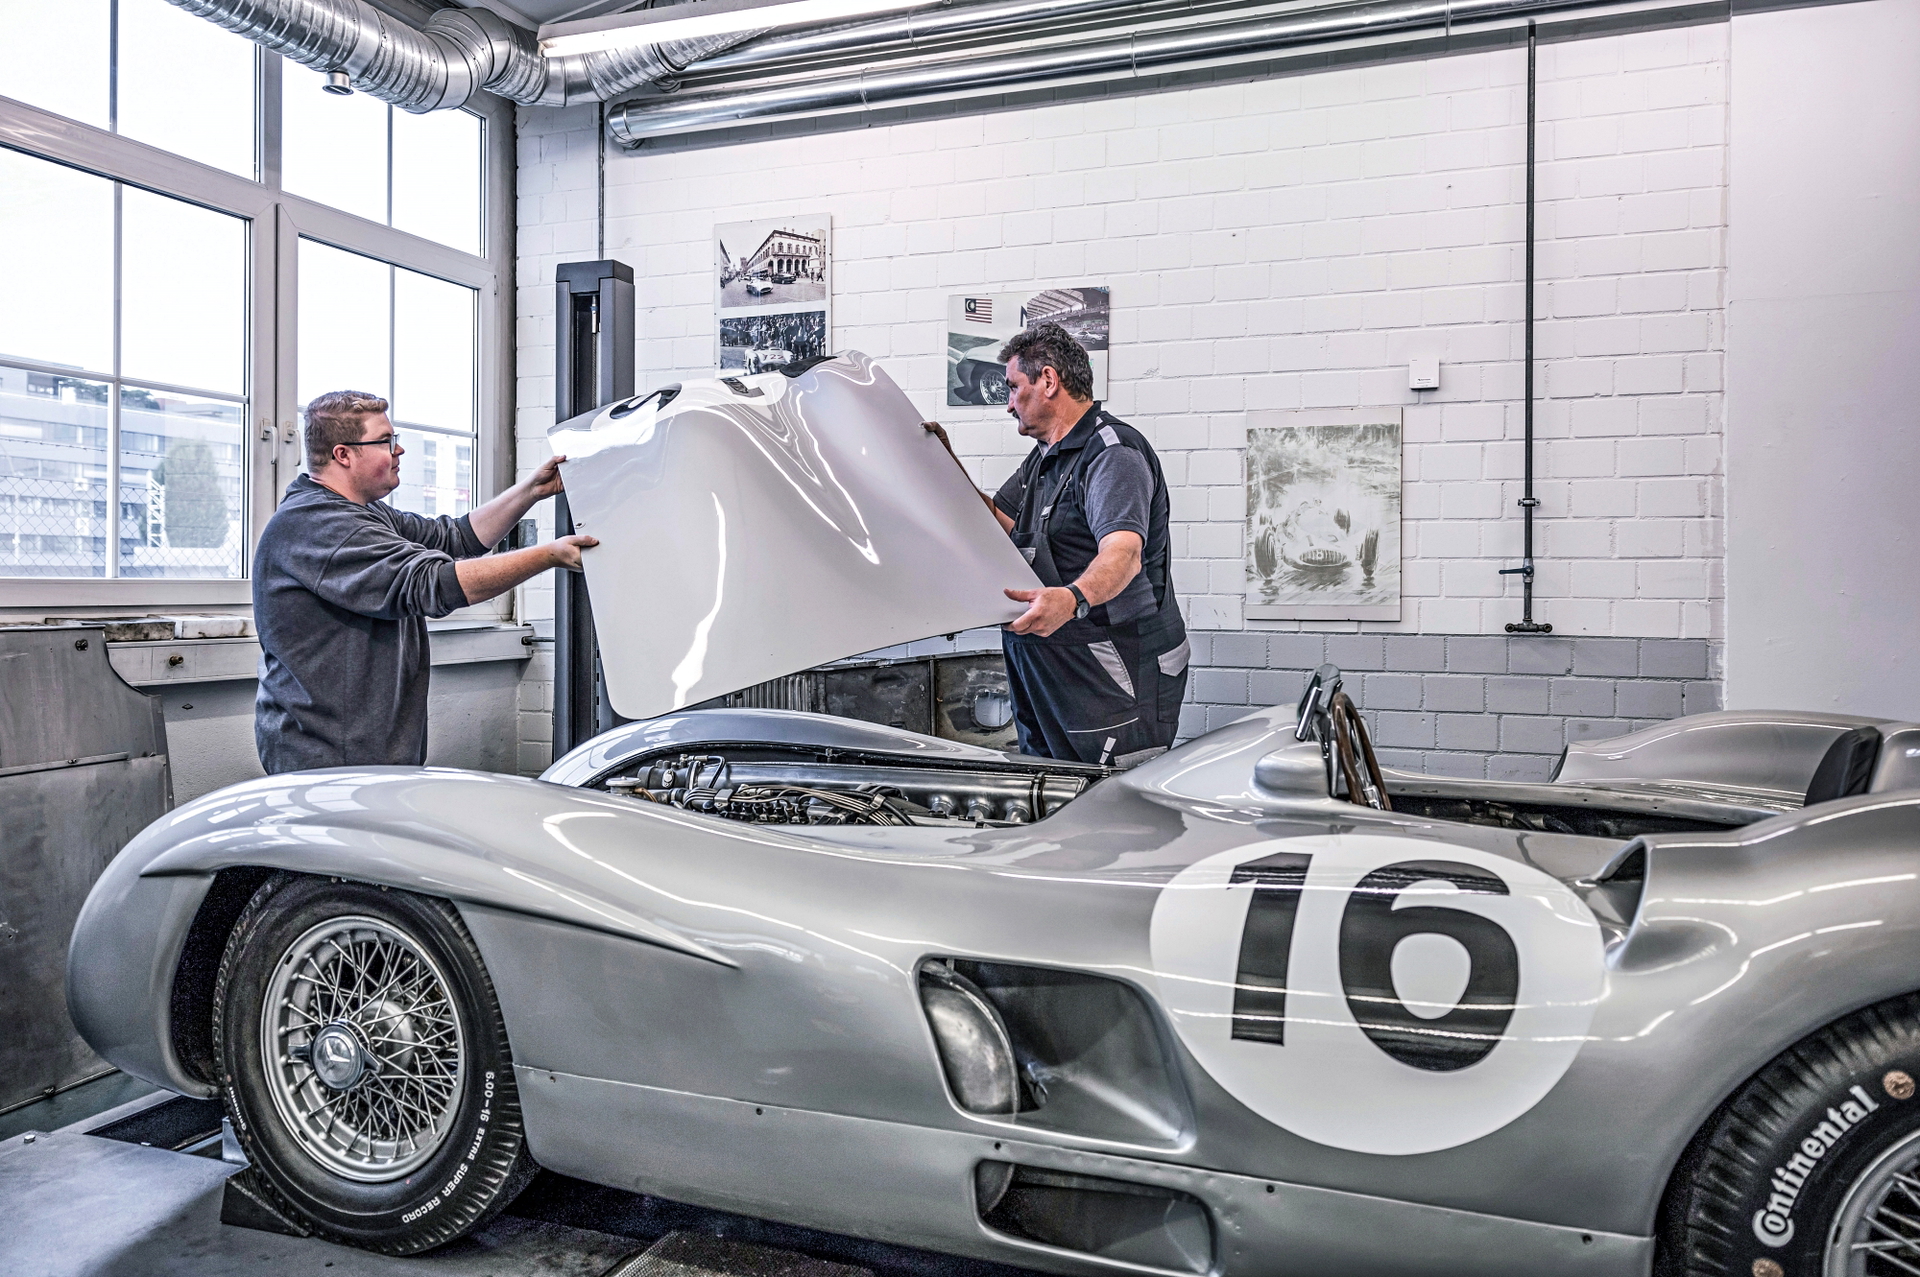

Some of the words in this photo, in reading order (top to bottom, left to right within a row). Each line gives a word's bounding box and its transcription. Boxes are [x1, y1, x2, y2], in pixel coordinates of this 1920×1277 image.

[1226, 851, 1520, 1072] 16
[467, 1127, 486, 1161] EXTRA
[441, 1163, 469, 1197] SUPER
[1752, 1085, 1879, 1247] Continental
[401, 1196, 441, 1224] RECORD
